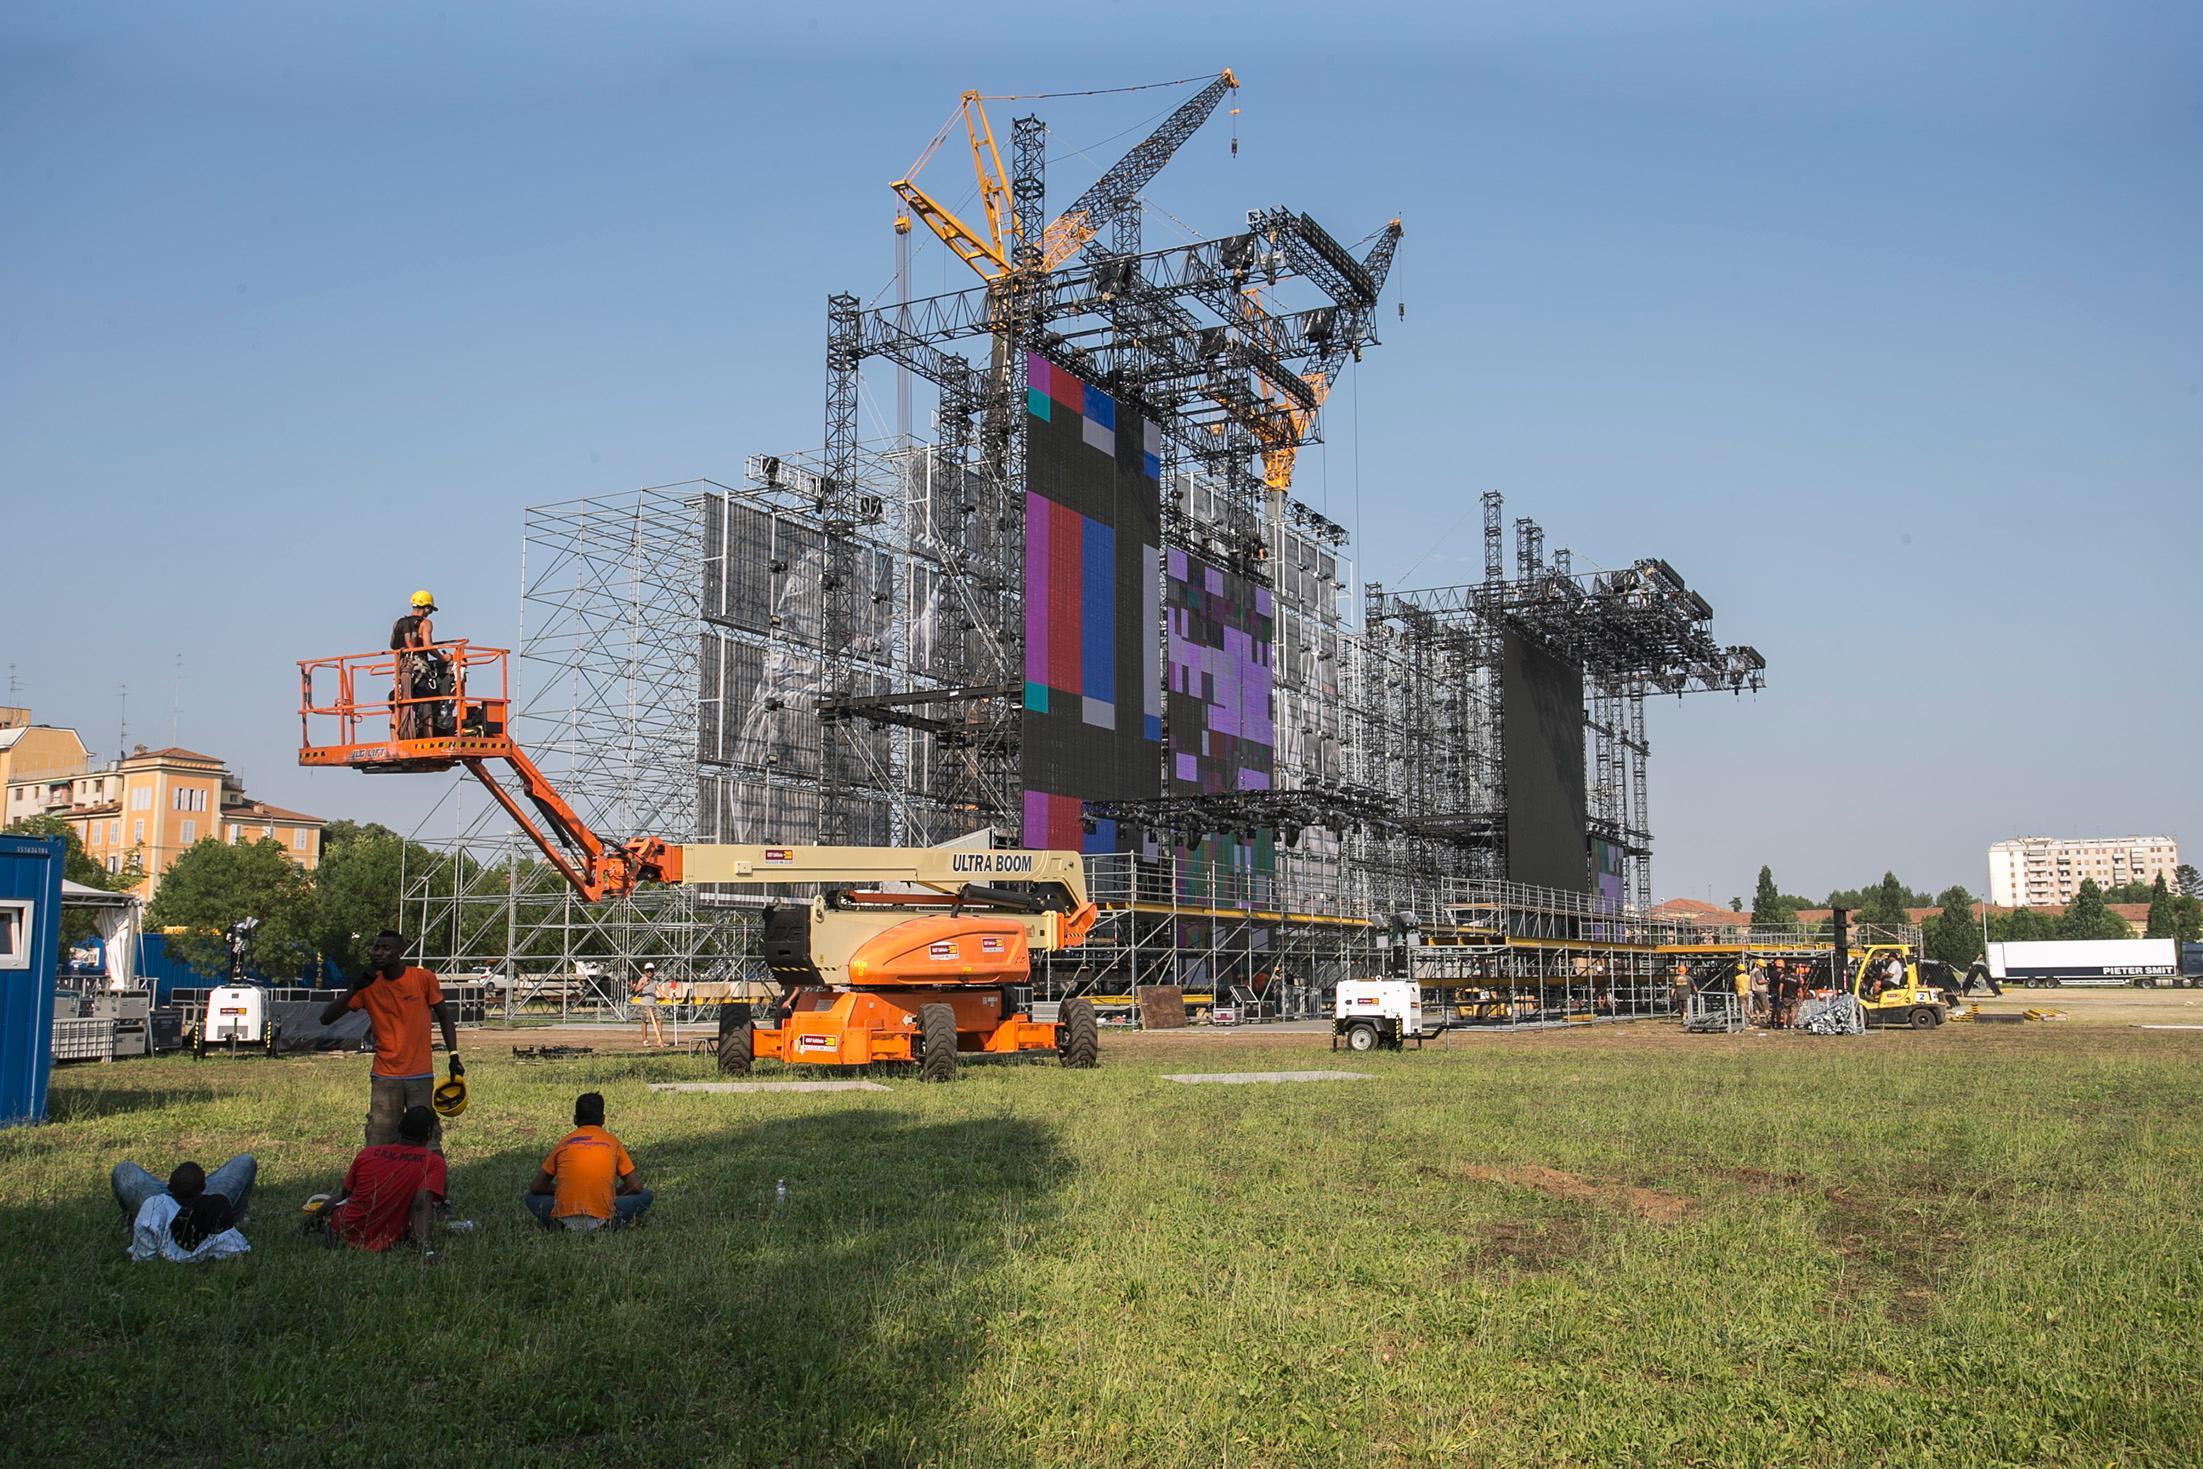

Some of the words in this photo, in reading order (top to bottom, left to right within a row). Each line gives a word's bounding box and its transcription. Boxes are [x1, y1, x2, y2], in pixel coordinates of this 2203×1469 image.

[368, 748, 385, 757] LIFT
[952, 854, 992, 872] ULTRA
[995, 855, 1032, 872] BOOM
[2103, 967, 2143, 975] PIETER
[2144, 966, 2173, 974] SMIT
